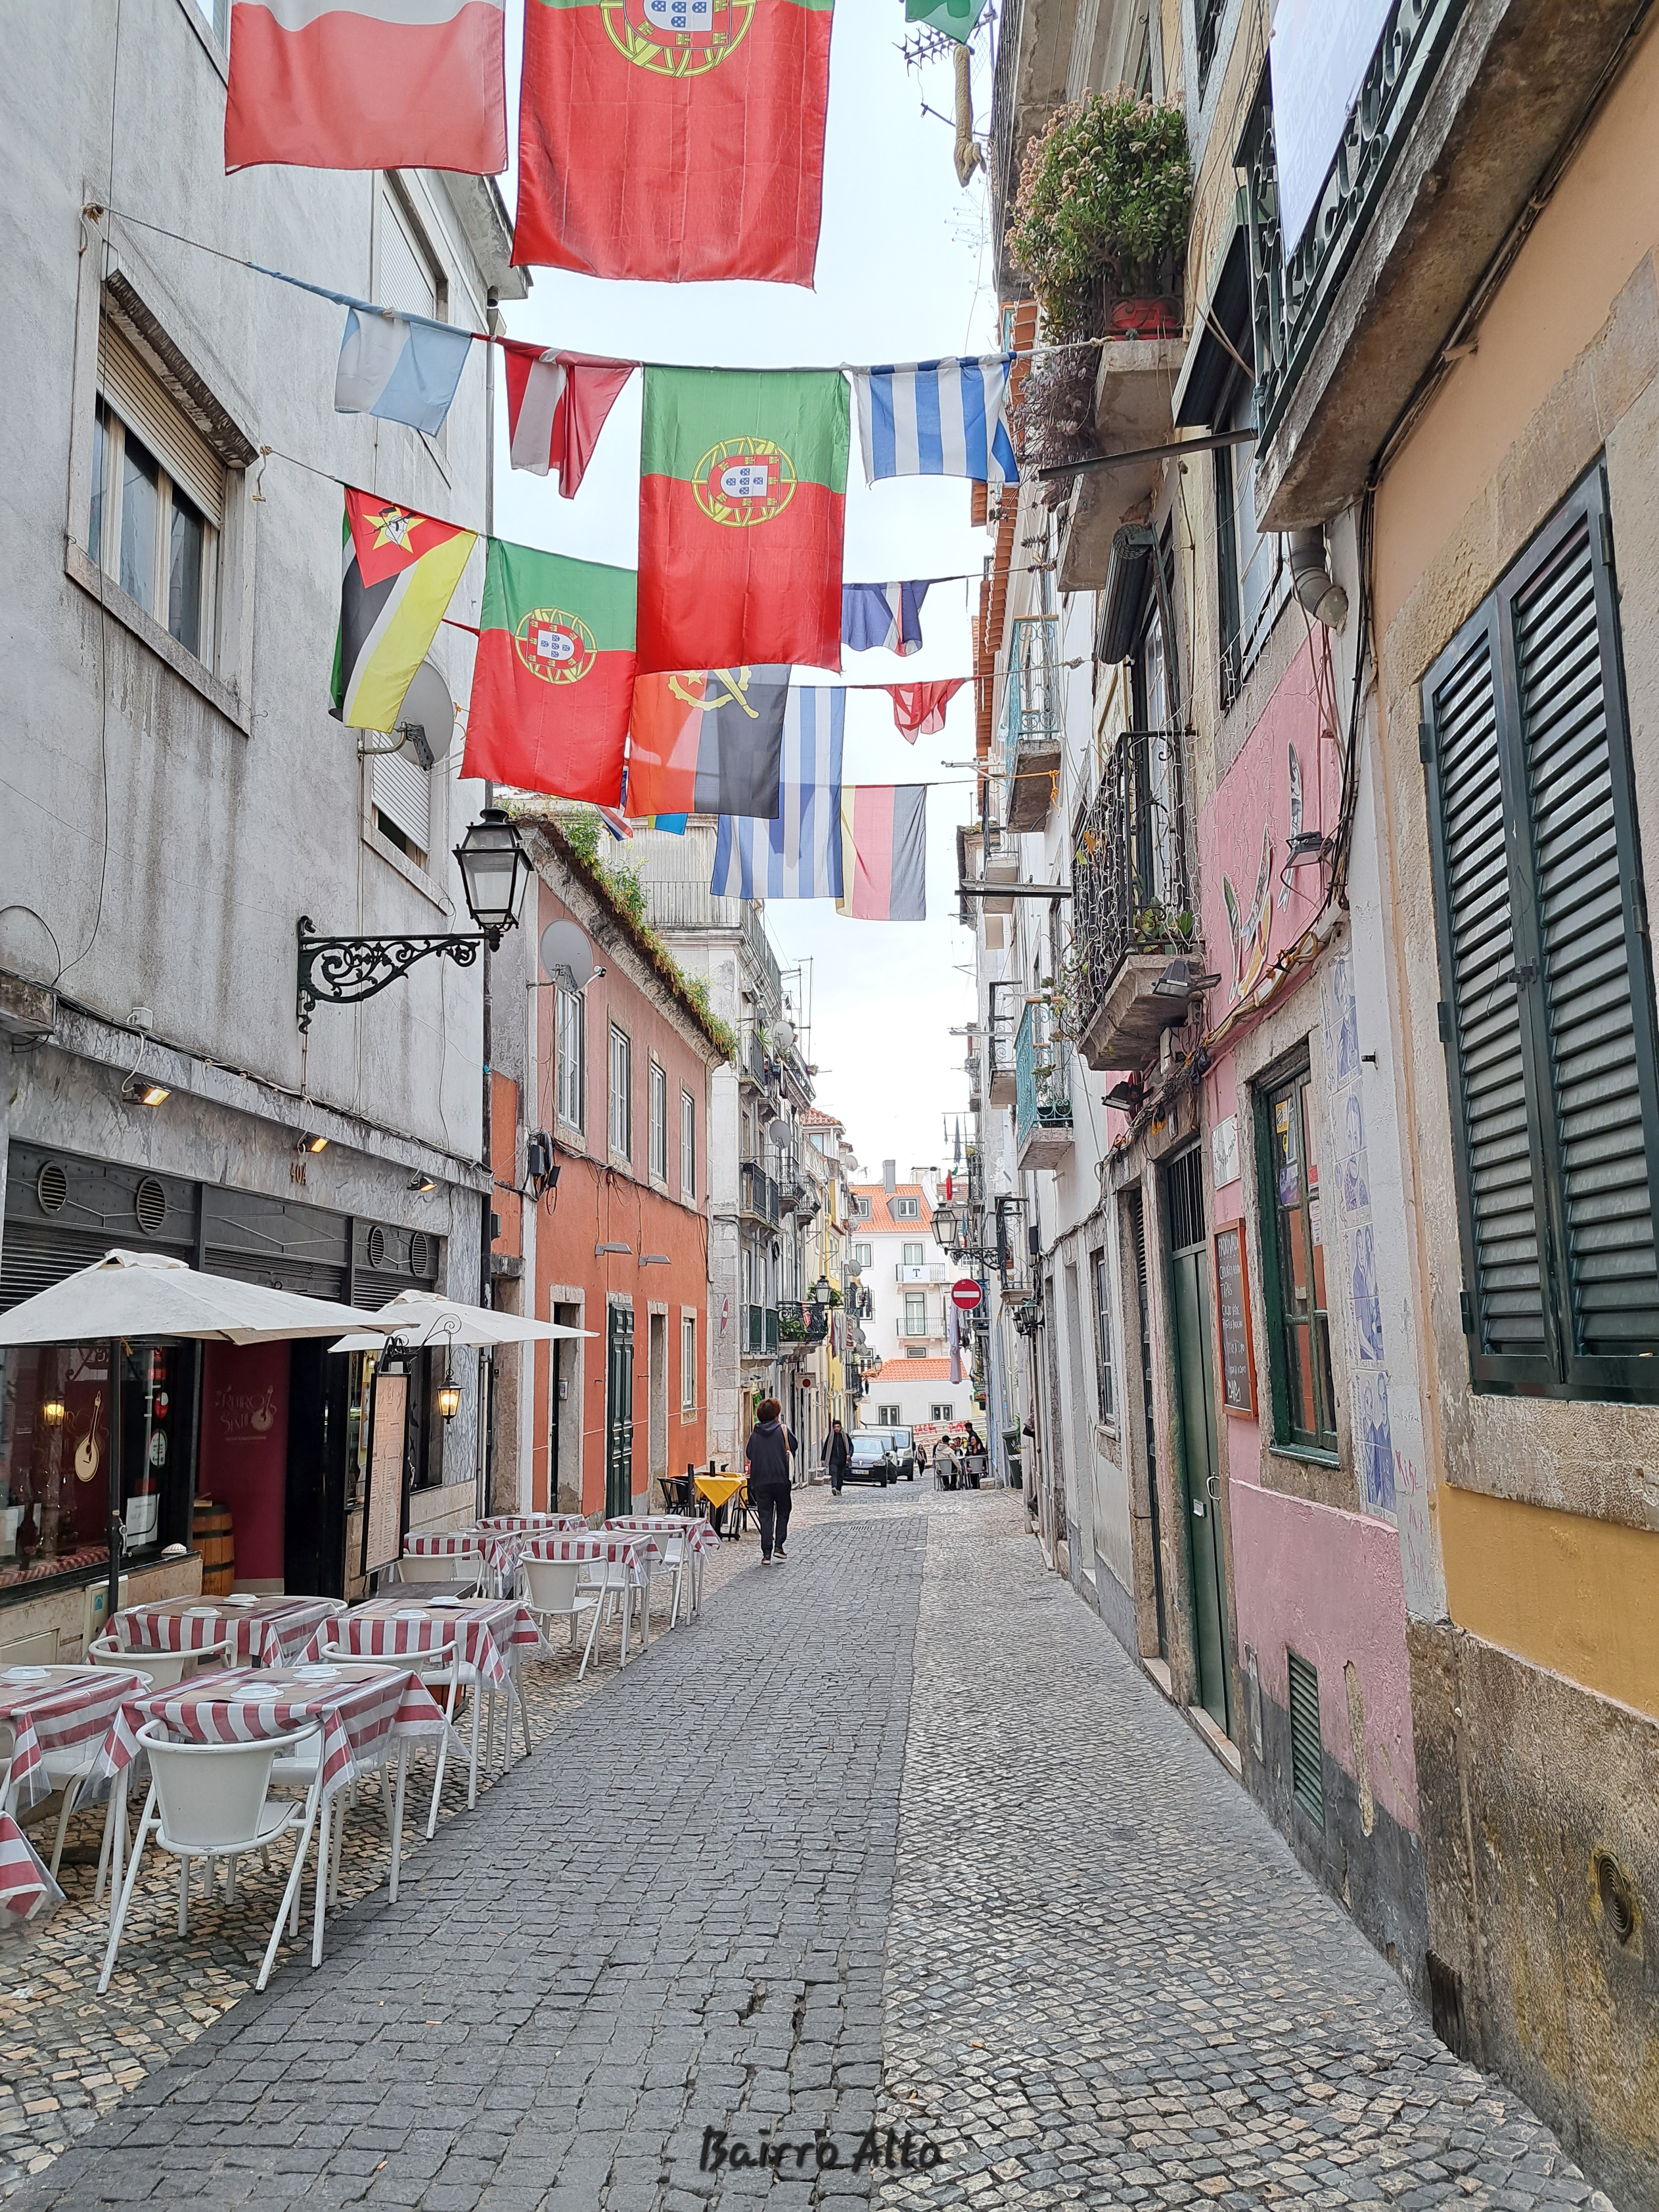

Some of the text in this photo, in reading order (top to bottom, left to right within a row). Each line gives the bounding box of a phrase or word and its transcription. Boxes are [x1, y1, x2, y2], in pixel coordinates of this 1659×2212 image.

[1286, 66, 1333, 205] RE/MAX
[1298, 154, 1312, 200] NEW
[1314, 99, 1335, 160] CYCLE
[290, 1161, 306, 1185] 40A
